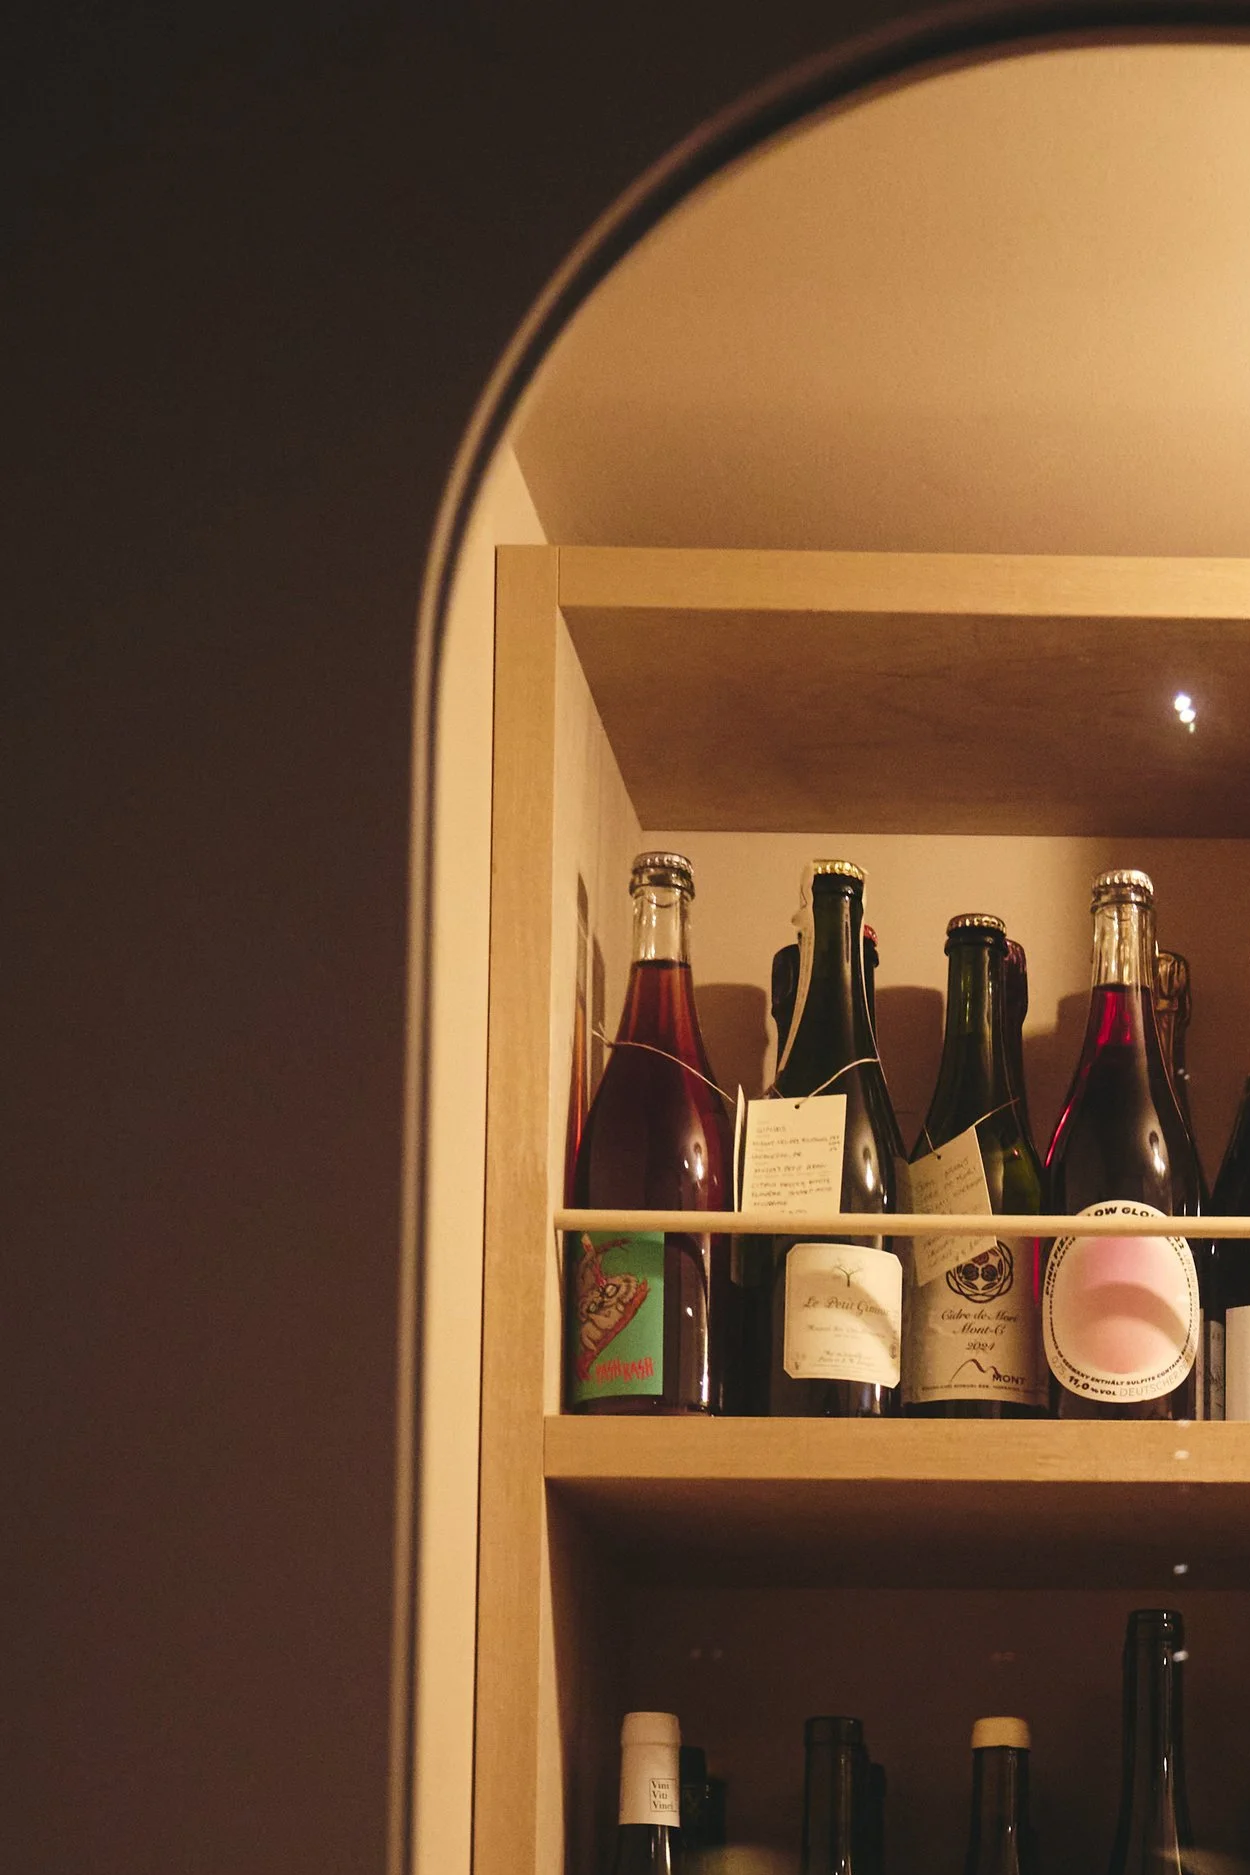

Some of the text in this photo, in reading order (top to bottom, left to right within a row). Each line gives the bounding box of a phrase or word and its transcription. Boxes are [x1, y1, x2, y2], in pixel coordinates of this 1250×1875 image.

[804, 1296, 820, 1308] Le
[824, 1296, 854, 1310] Petit
[941, 1308, 972, 1321] Cidre
[974, 1309, 990, 1320] de
[966, 1342, 995, 1351] 2024
[992, 1374, 1024, 1385] MONT
[651, 1780, 670, 1790] Vini
[652, 1790, 668, 1800] Viti
[653, 1800, 674, 1810] Vinci
